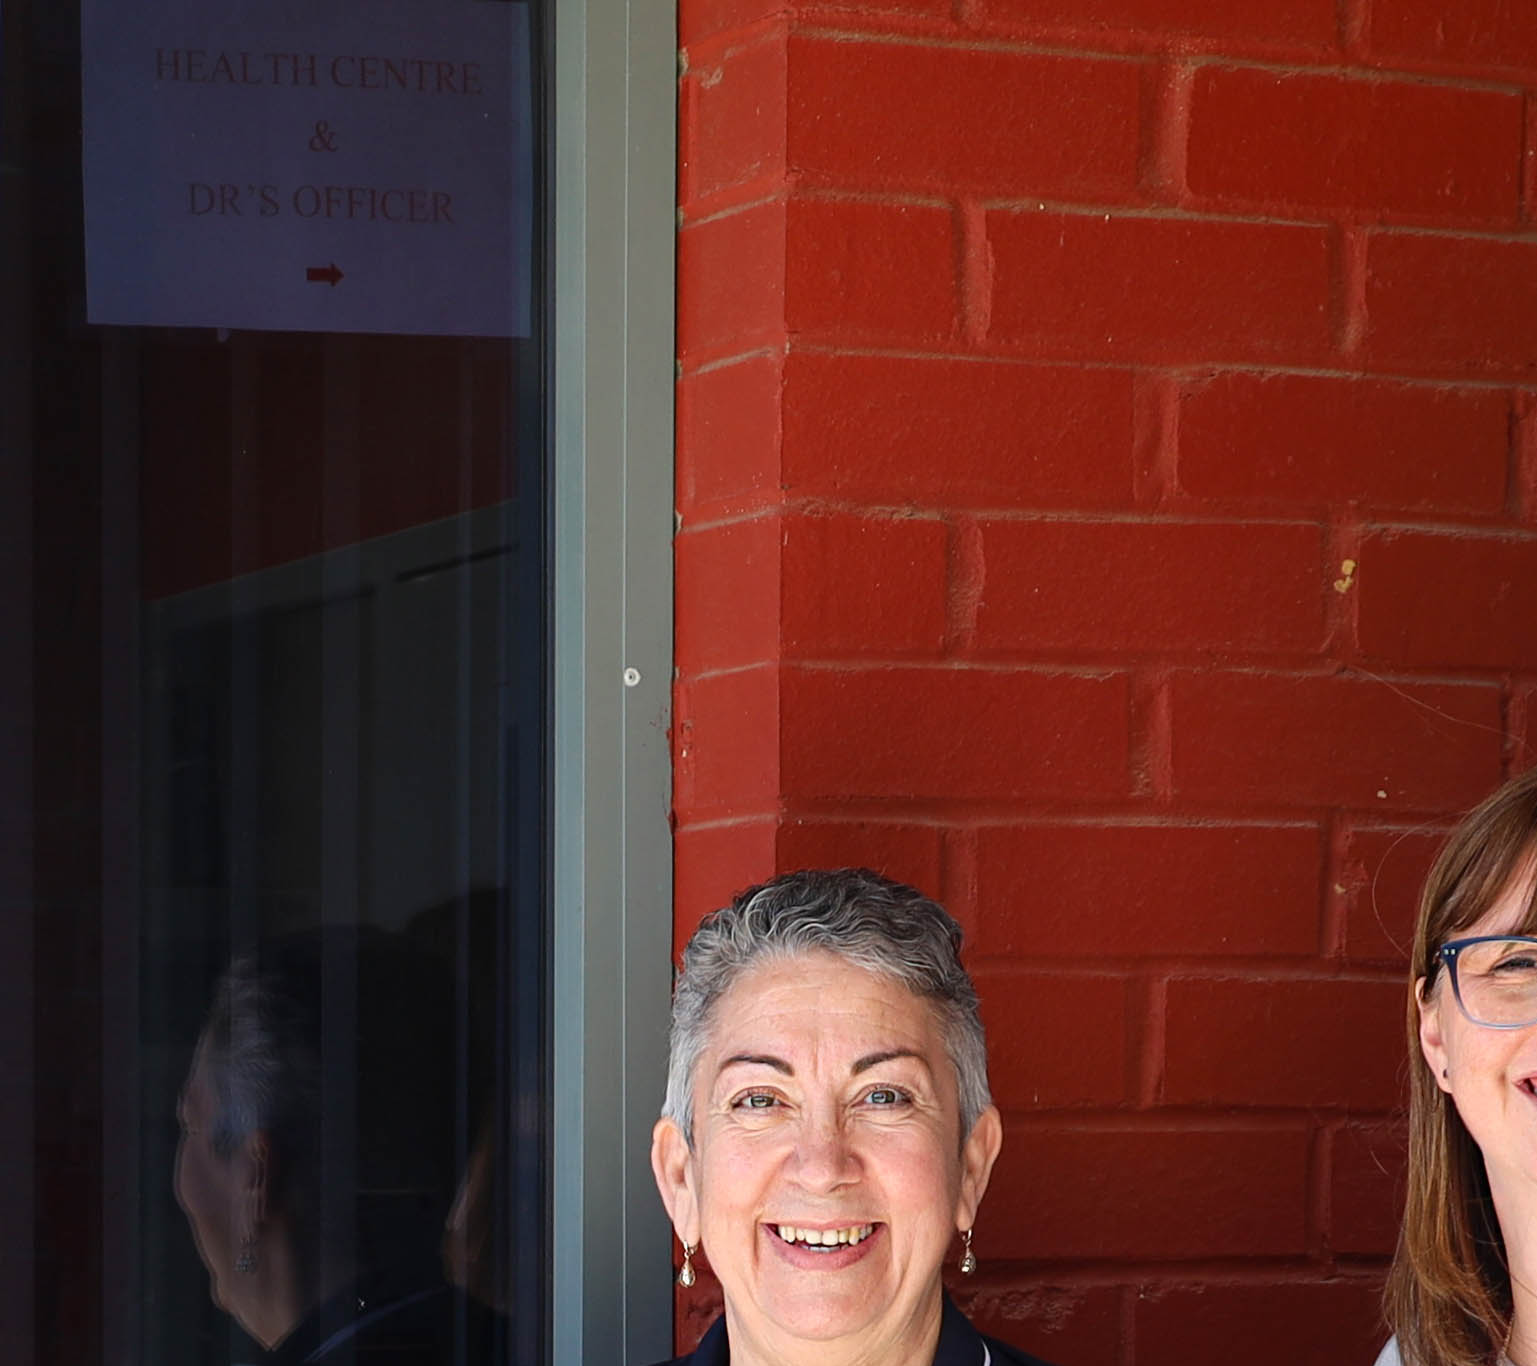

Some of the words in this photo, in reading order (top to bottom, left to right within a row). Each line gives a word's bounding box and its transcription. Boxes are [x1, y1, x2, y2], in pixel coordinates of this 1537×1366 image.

[155, 48, 319, 87] HEALTH
[330, 55, 484, 96] CENTRE
[308, 120, 338, 153] &
[187, 183, 282, 217] DR'S
[292, 184, 455, 224] OFFICER
